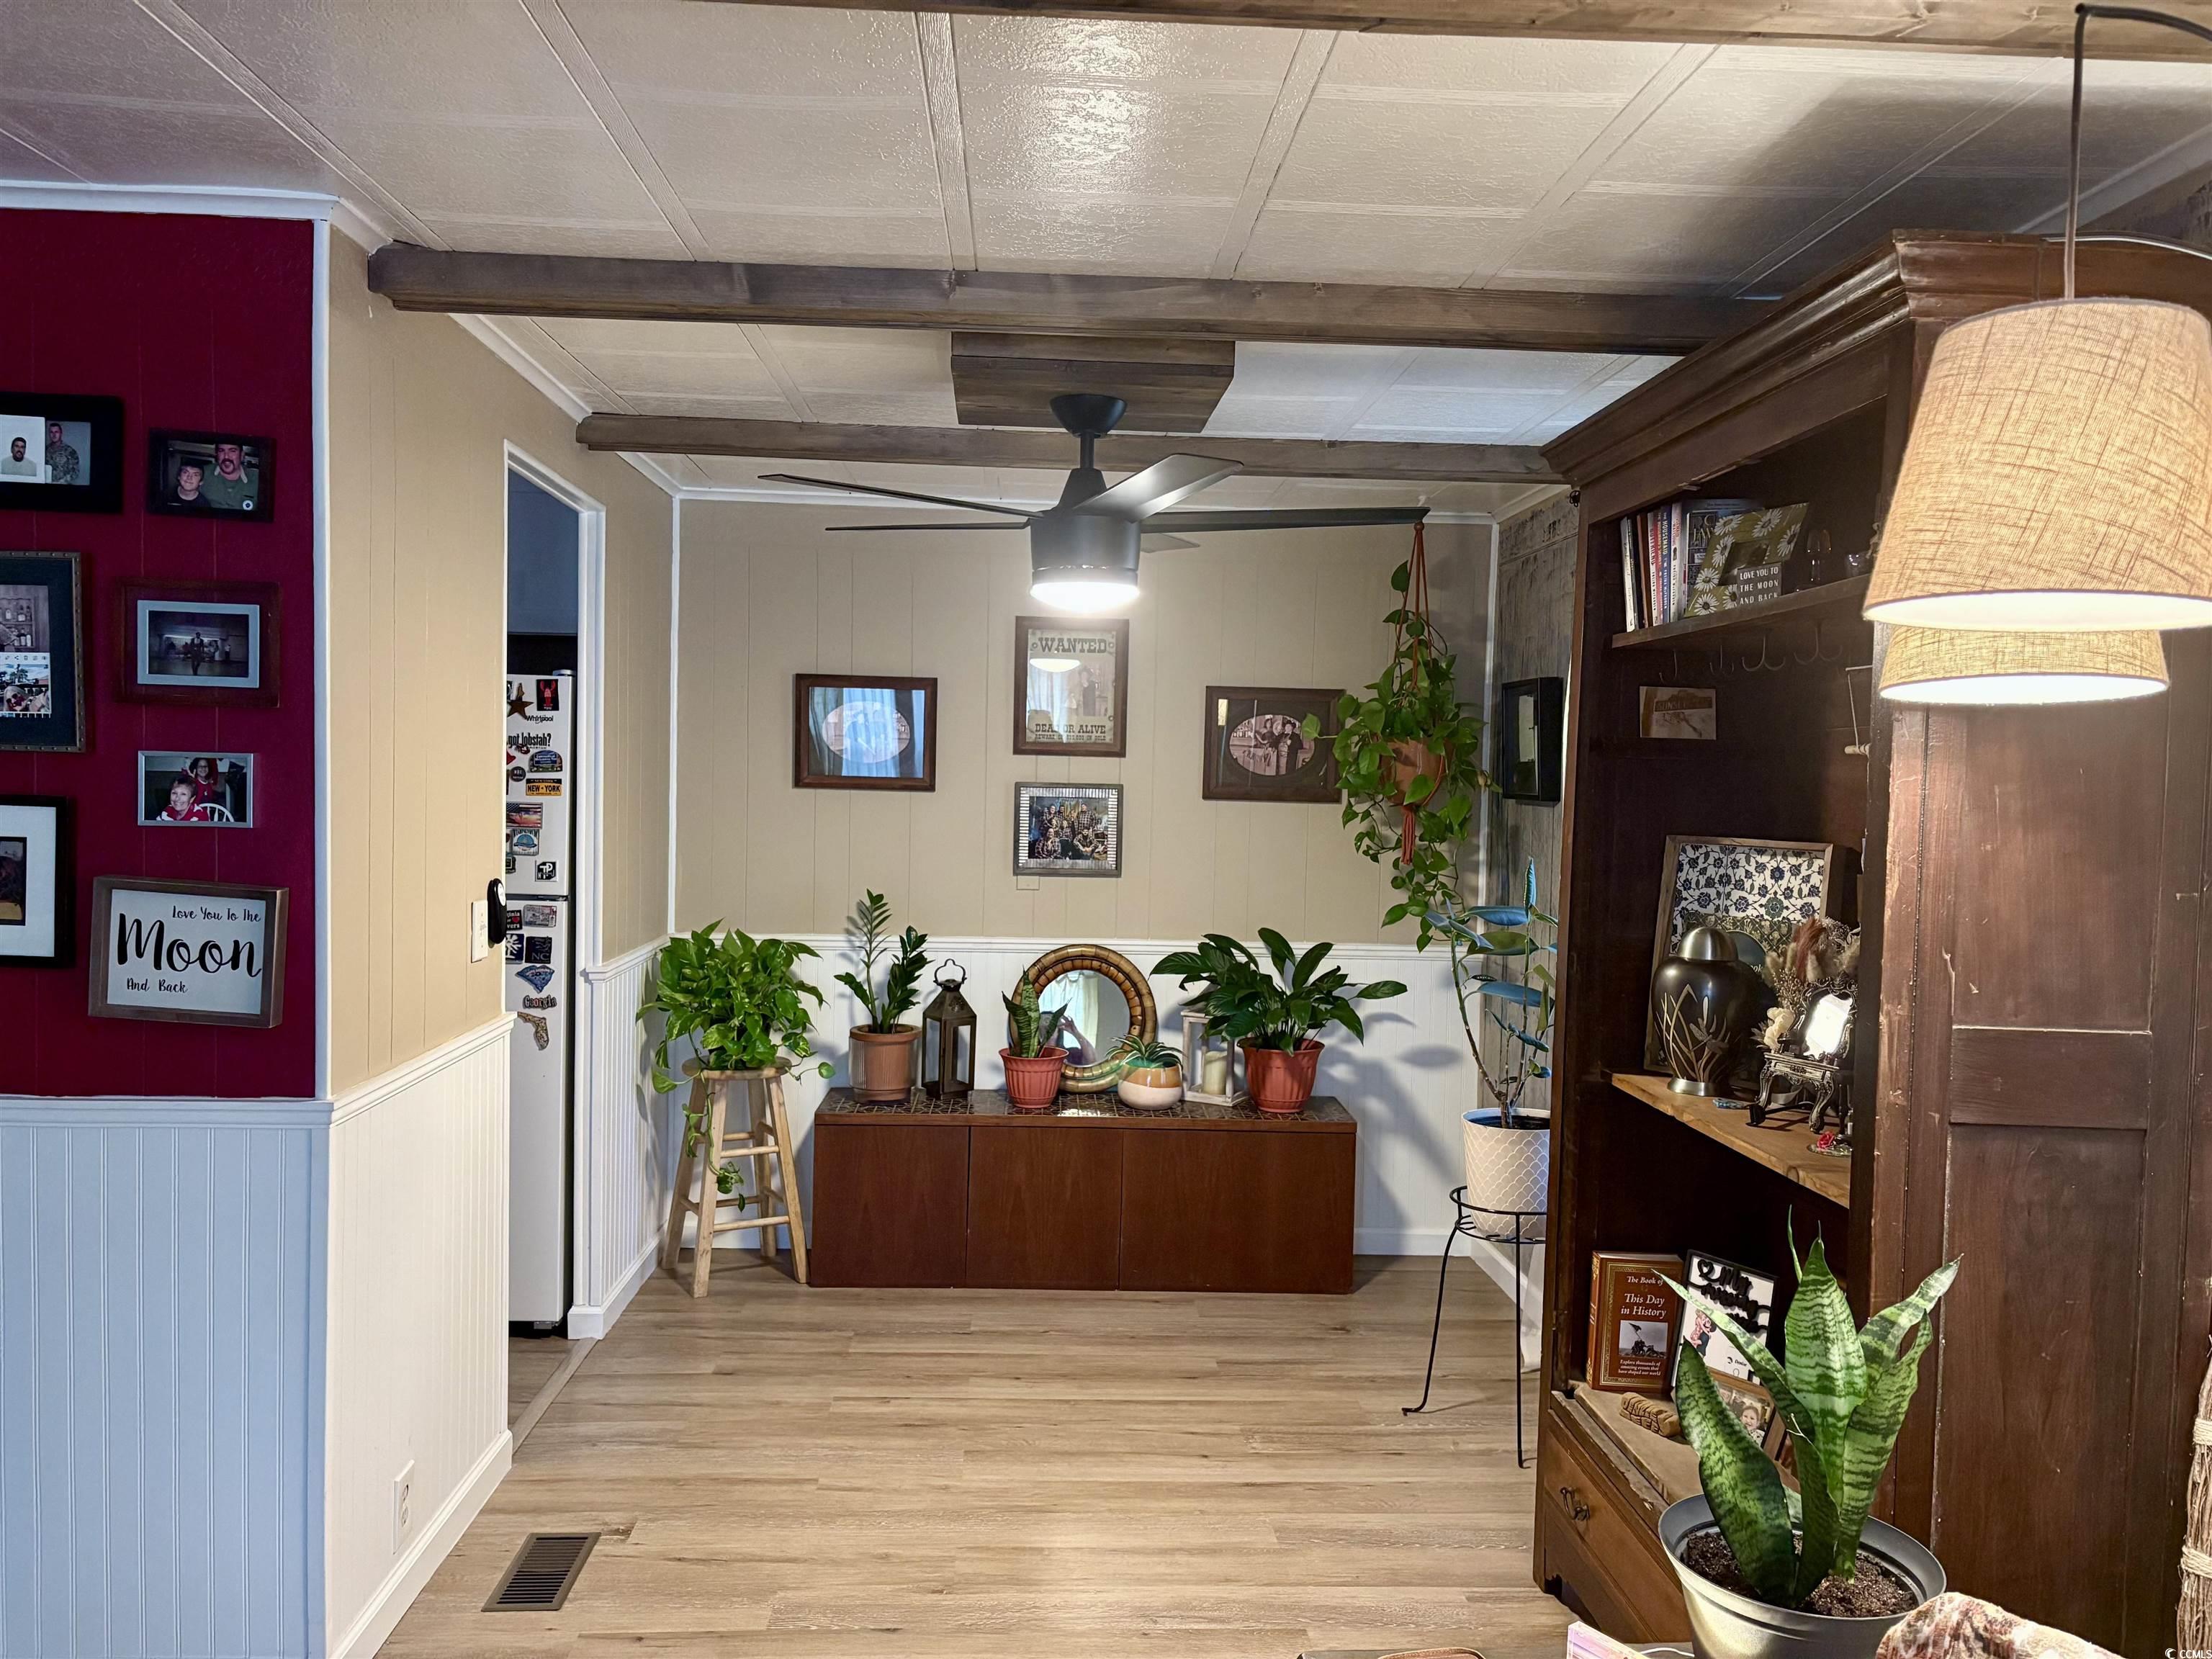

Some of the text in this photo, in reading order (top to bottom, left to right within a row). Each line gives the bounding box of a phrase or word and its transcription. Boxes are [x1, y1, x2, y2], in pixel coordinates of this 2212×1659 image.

[1740, 570, 1755, 580] LOVE
[1756, 568, 1768, 577] YOU
[1740, 580, 1779, 593] THE MOON
[1740, 593, 1778, 605] AND BACK
[1038, 638, 1107, 654] WANTED
[526, 715, 554, 724] Whirlpool
[1064, 724, 1074, 733] OR
[1078, 724, 1106, 734] ALIVE
[508, 732, 552, 748] got lobstah?
[172, 905, 261, 922] Love You To The
[117, 913, 262, 977] Moon
[127, 978, 188, 993] And Back
[525, 995, 557, 1009] Georgia
[1624, 1293, 1665, 1307] This Day
[1621, 1305, 1666, 1319] in History
